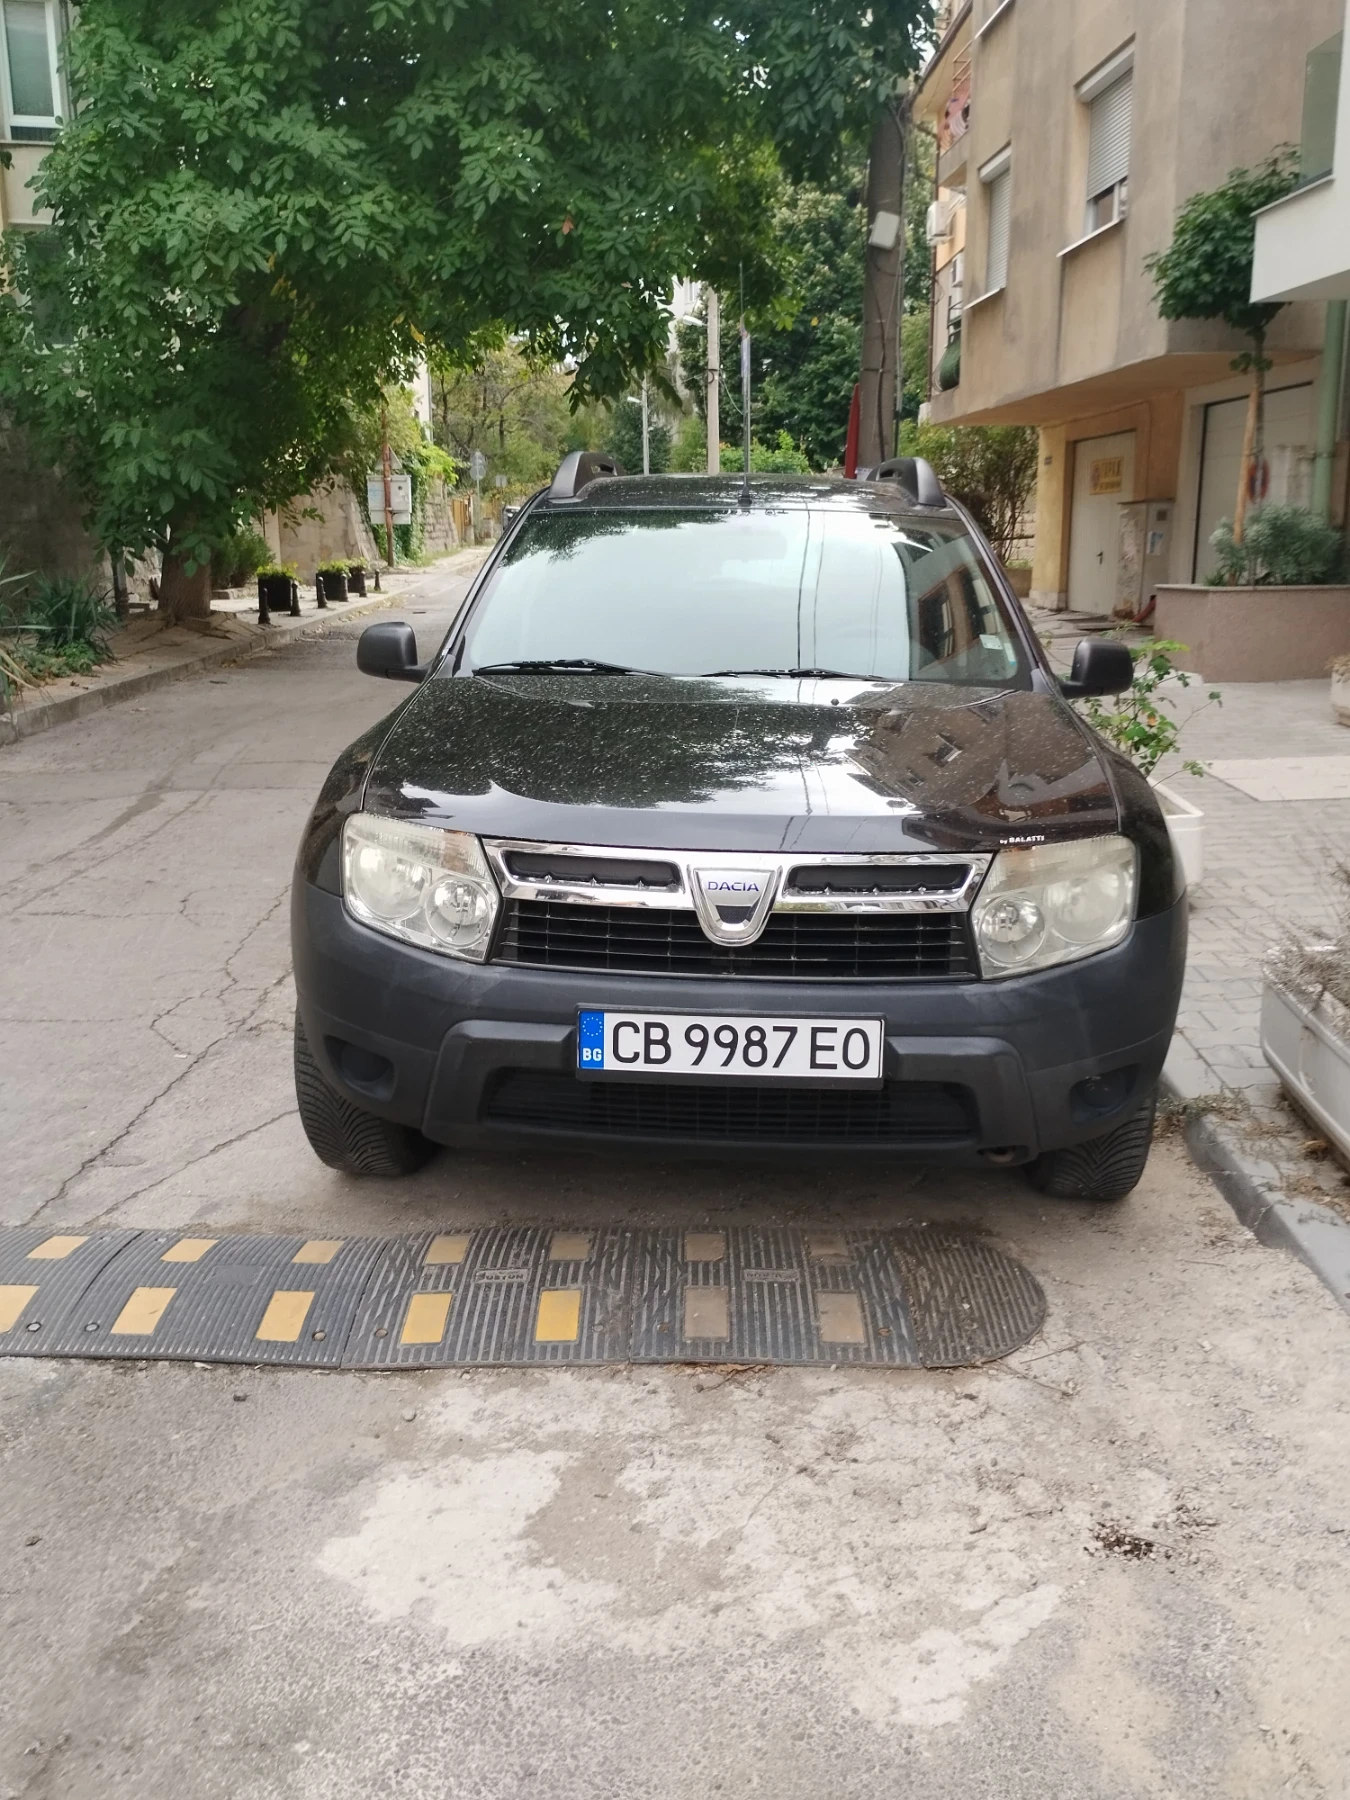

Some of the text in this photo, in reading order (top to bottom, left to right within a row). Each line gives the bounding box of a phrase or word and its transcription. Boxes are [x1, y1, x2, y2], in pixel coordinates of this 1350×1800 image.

[1009, 835, 1044, 843] BALATTI
[708, 881, 759, 891] DACIA
[612, 1020, 672, 1065] CB
[684, 1023, 798, 1069] 9987
[582, 1048, 603, 1062] BG
